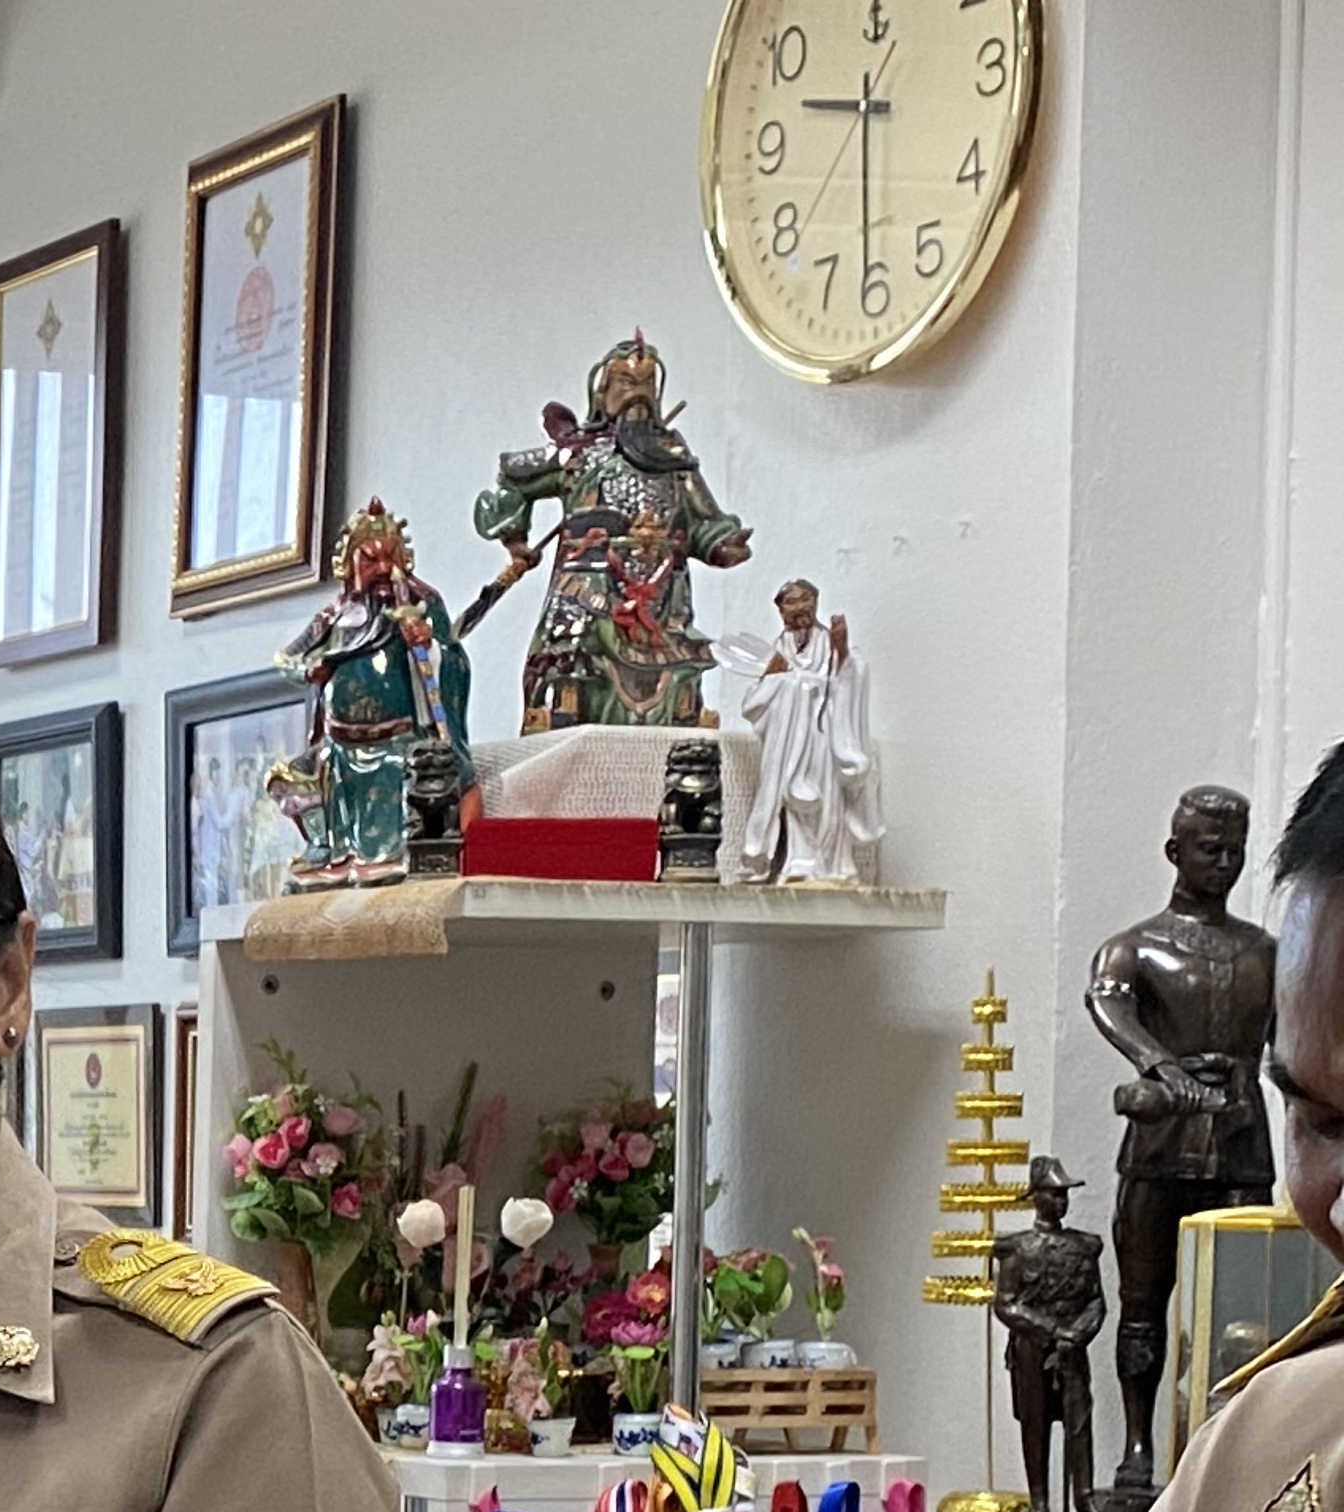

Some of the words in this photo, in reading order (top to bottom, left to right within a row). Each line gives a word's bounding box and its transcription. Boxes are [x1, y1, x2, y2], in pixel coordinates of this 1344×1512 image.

[765, 25, 807, 86] 10
[975, 37, 1007, 97] 3
[757, 120, 785, 175] 9
[956, 136, 987, 196] 4
[772, 201, 799, 257] 8
[915, 220, 944, 279] 5
[813, 254, 840, 312] 7
[862, 260, 891, 318] 6
